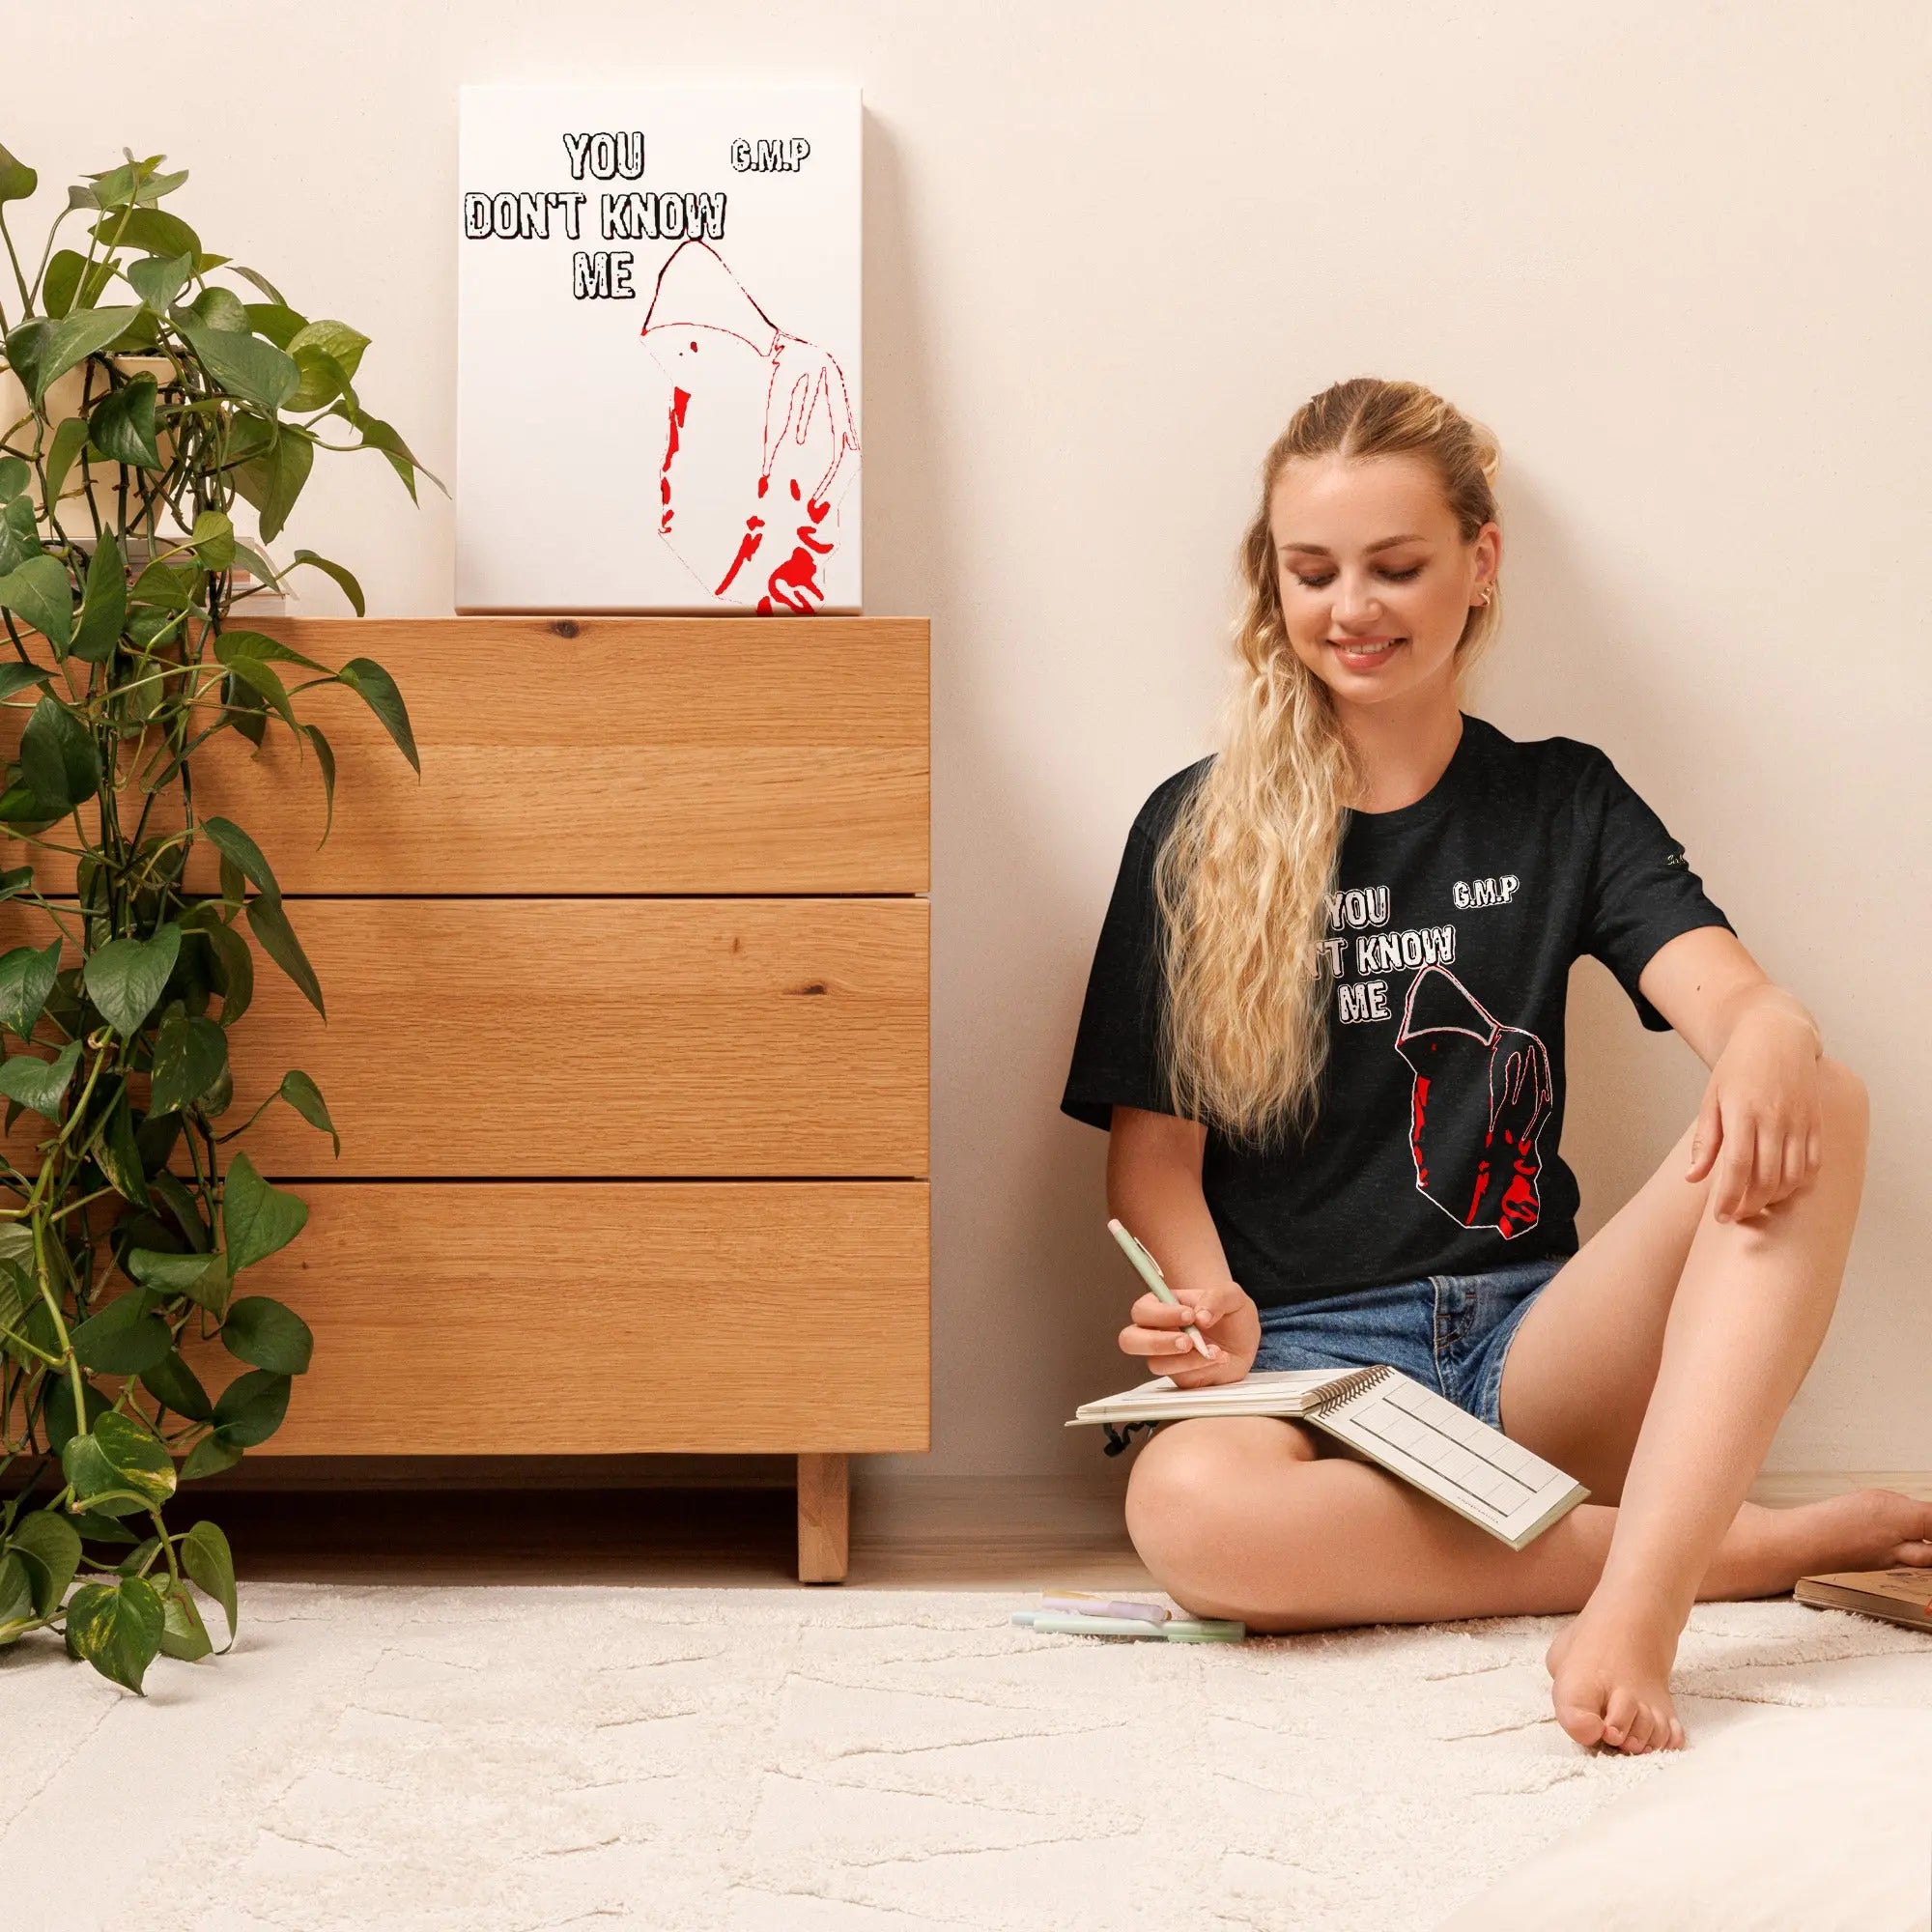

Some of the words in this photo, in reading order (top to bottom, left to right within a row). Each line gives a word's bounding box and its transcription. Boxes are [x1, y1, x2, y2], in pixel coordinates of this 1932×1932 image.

[563, 131, 644, 181] YOU
[731, 138, 810, 172] G.M.P
[465, 192, 586, 240] DON'T
[601, 192, 726, 240] KNOW
[573, 251, 636, 299] ME
[1322, 886, 1390, 930] YOU
[1453, 875, 1520, 909] G.M.P
[1356, 924, 1456, 975] KNOW
[1338, 980, 1391, 1024] ME
